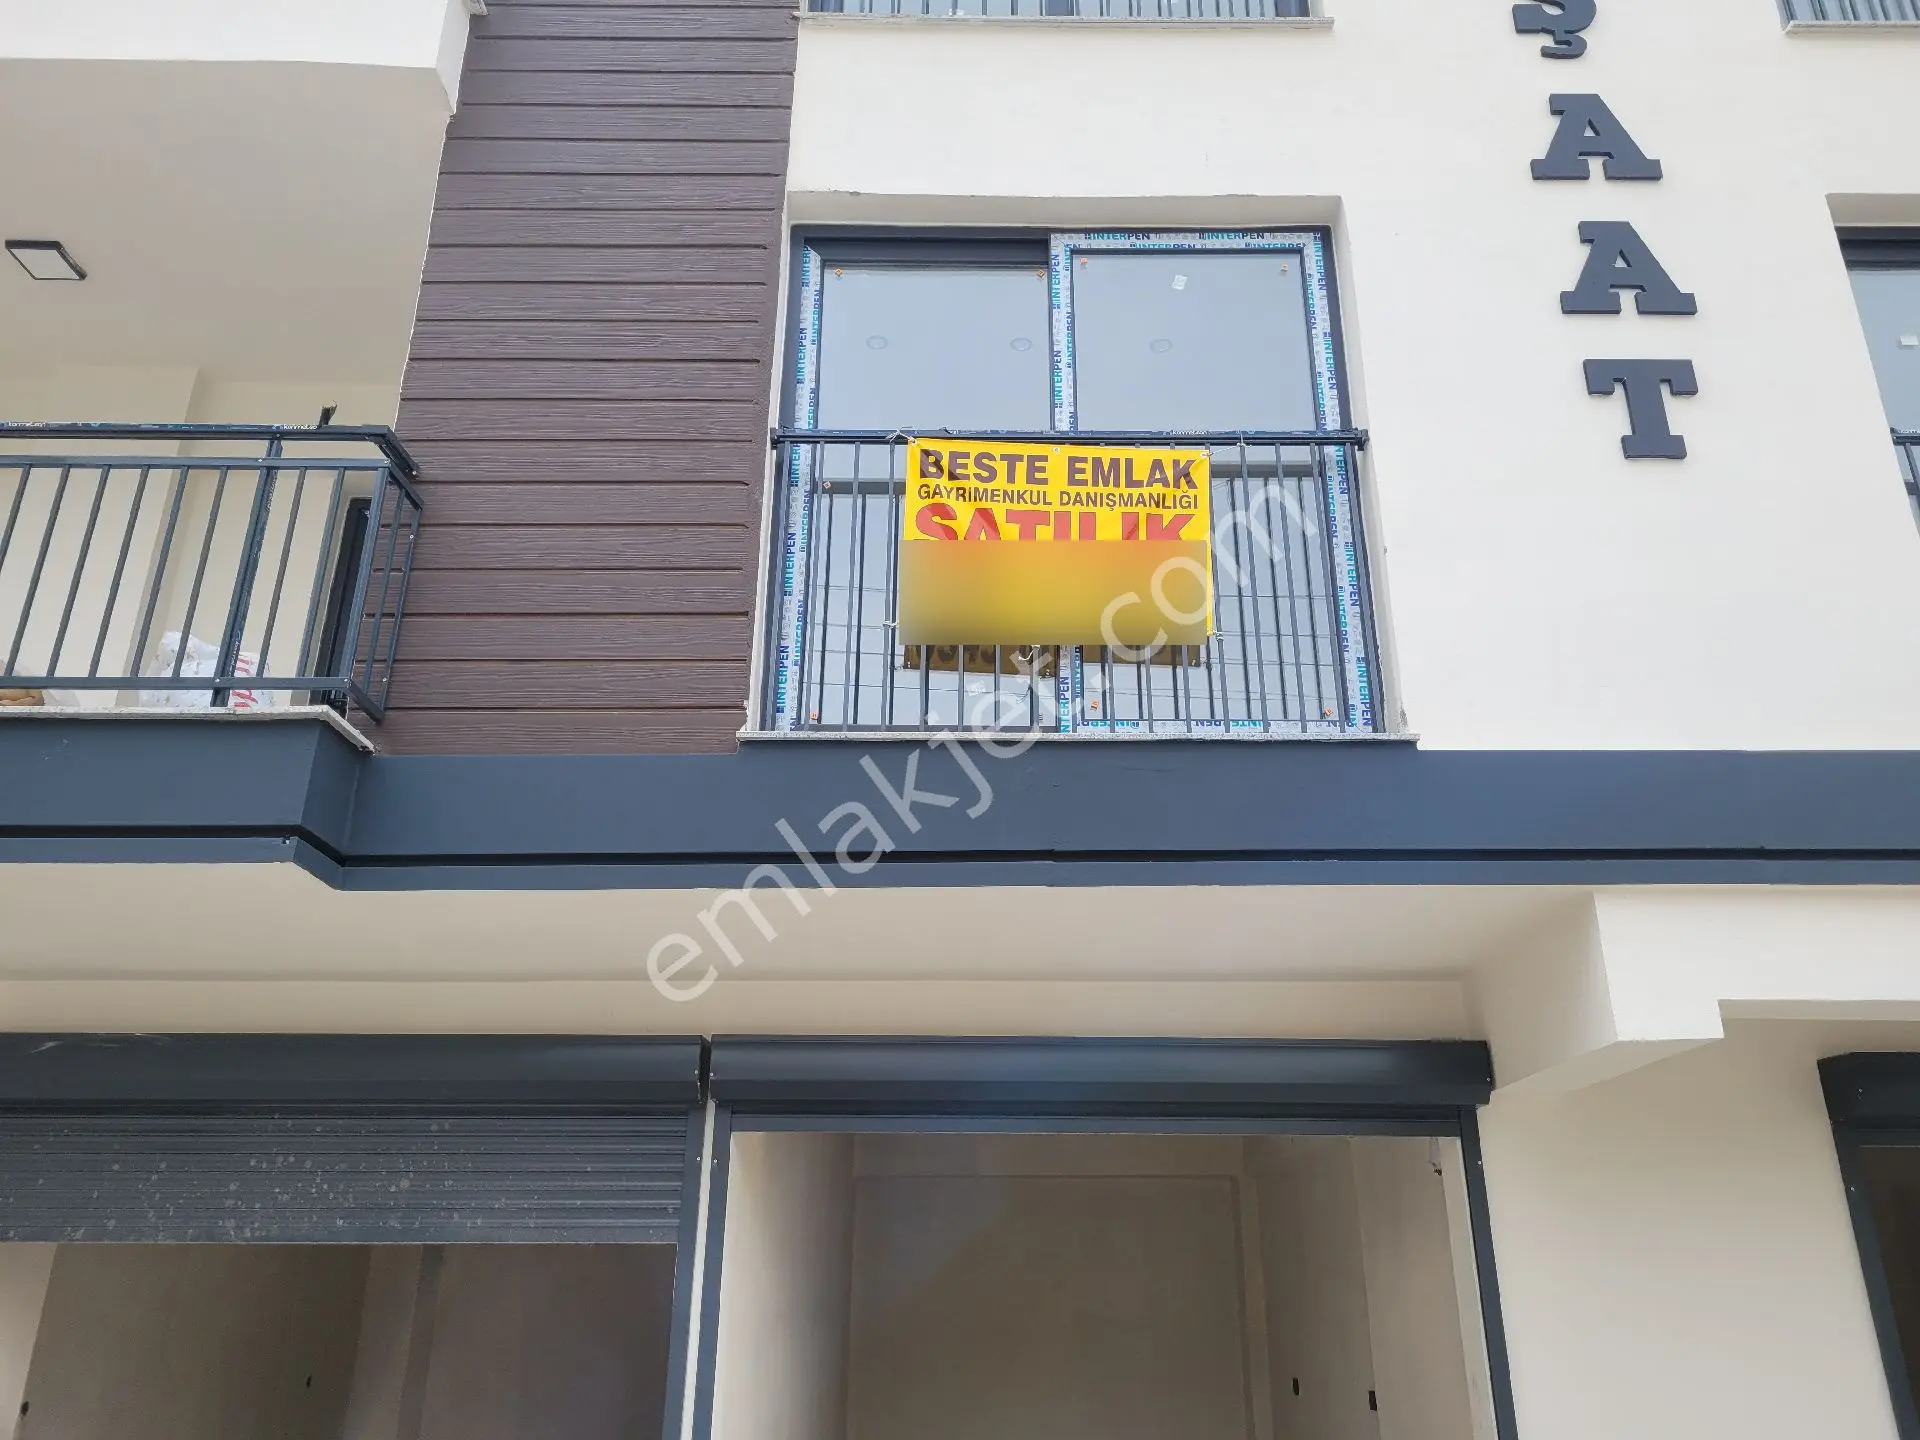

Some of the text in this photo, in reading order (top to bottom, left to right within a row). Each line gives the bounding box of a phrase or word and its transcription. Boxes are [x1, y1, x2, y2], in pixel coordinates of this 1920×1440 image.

[1092, 232, 1150, 241] INTERPEN
[1206, 231, 1265, 240] INTERPEN
[1051, 254, 1061, 302] INTERPEN
[1313, 241, 1327, 291] INTERPEN
[797, 327, 808, 377] INTERPEN
[1053, 350, 1064, 402] INTERPEN
[1324, 337, 1337, 390] INTERPEN
[919, 448, 1199, 490] BESTE EMLAK
[917, 483, 1199, 512] GAYRİMENKUL DANIŞMANLIĞI
[784, 532, 797, 589] INTERPEN
[1345, 548, 1361, 607] INTERPEN
[776, 645, 790, 706] INTERPEN
[1356, 664, 1374, 727] INTERPEN
